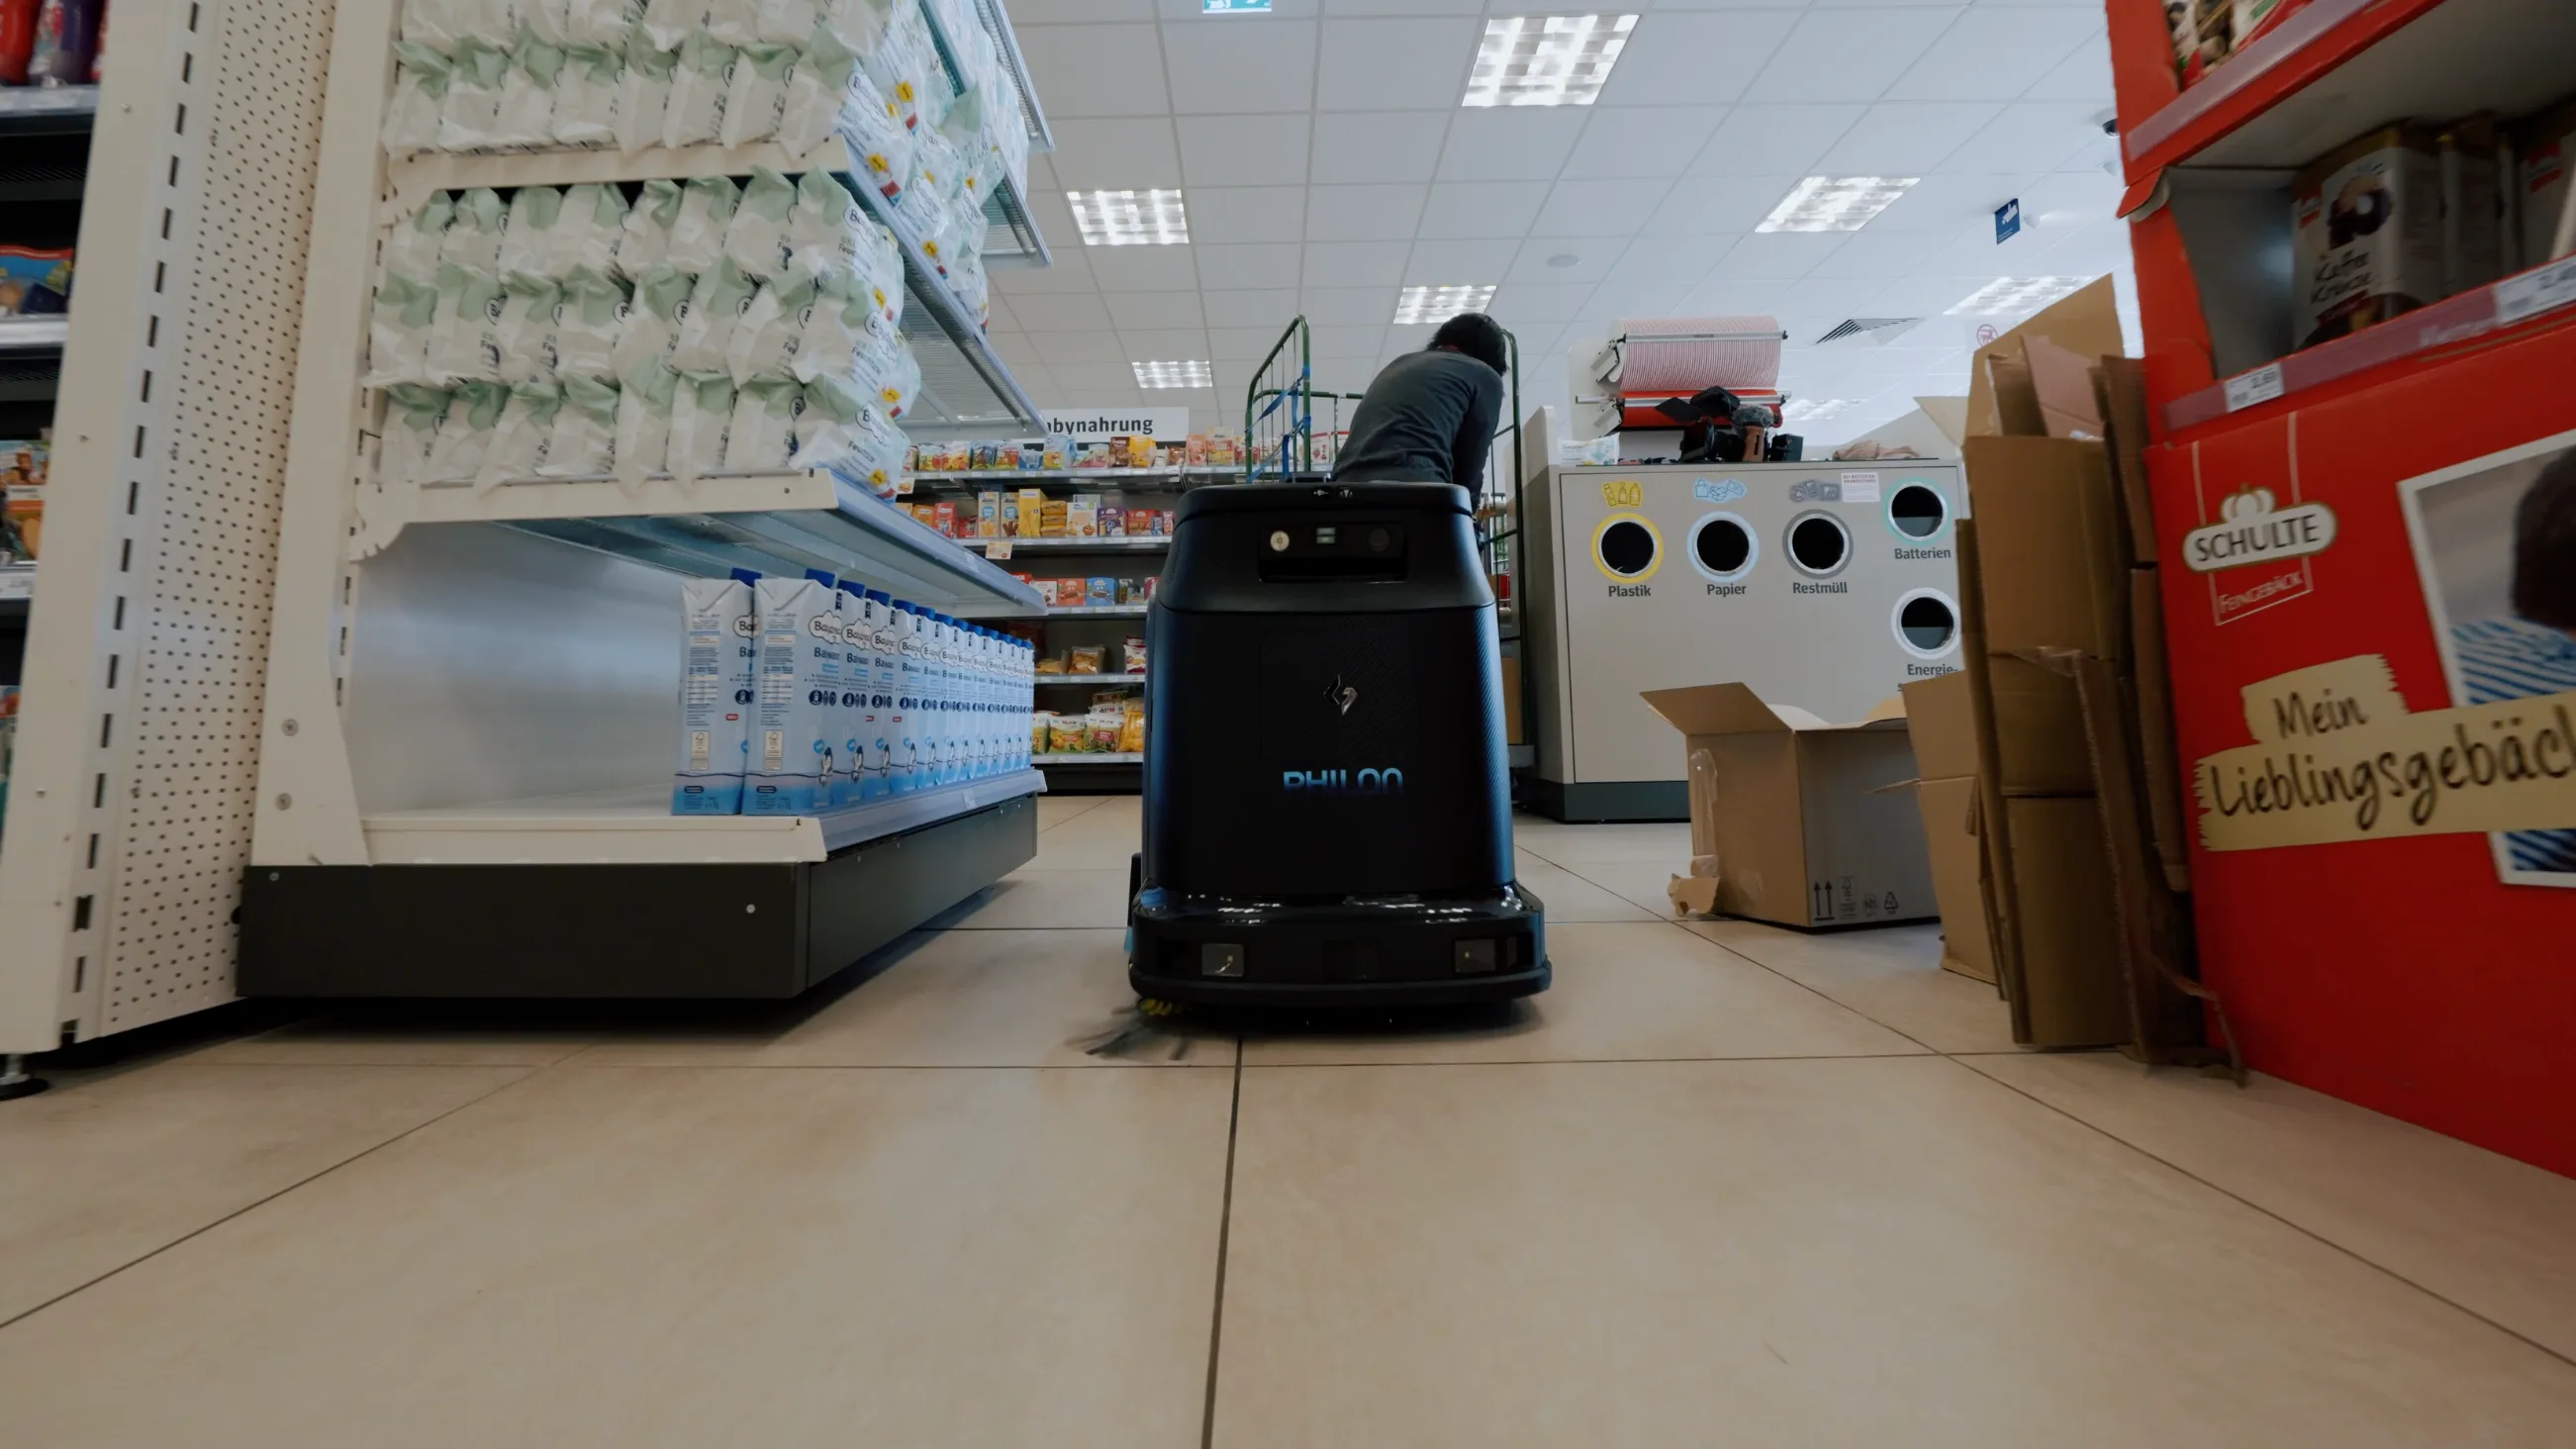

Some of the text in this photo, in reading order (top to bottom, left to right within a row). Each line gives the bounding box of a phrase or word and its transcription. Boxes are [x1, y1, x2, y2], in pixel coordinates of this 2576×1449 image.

[1047, 416, 1153, 435] bynahrung
[2194, 513, 2321, 562] SCHULTE
[1894, 547, 1952, 560] Batterien
[1607, 583, 1652, 598] Plastik
[1706, 583, 1747, 598] Papier
[1792, 581, 1849, 595] Restmüll
[2273, 688, 2369, 740] Mein
